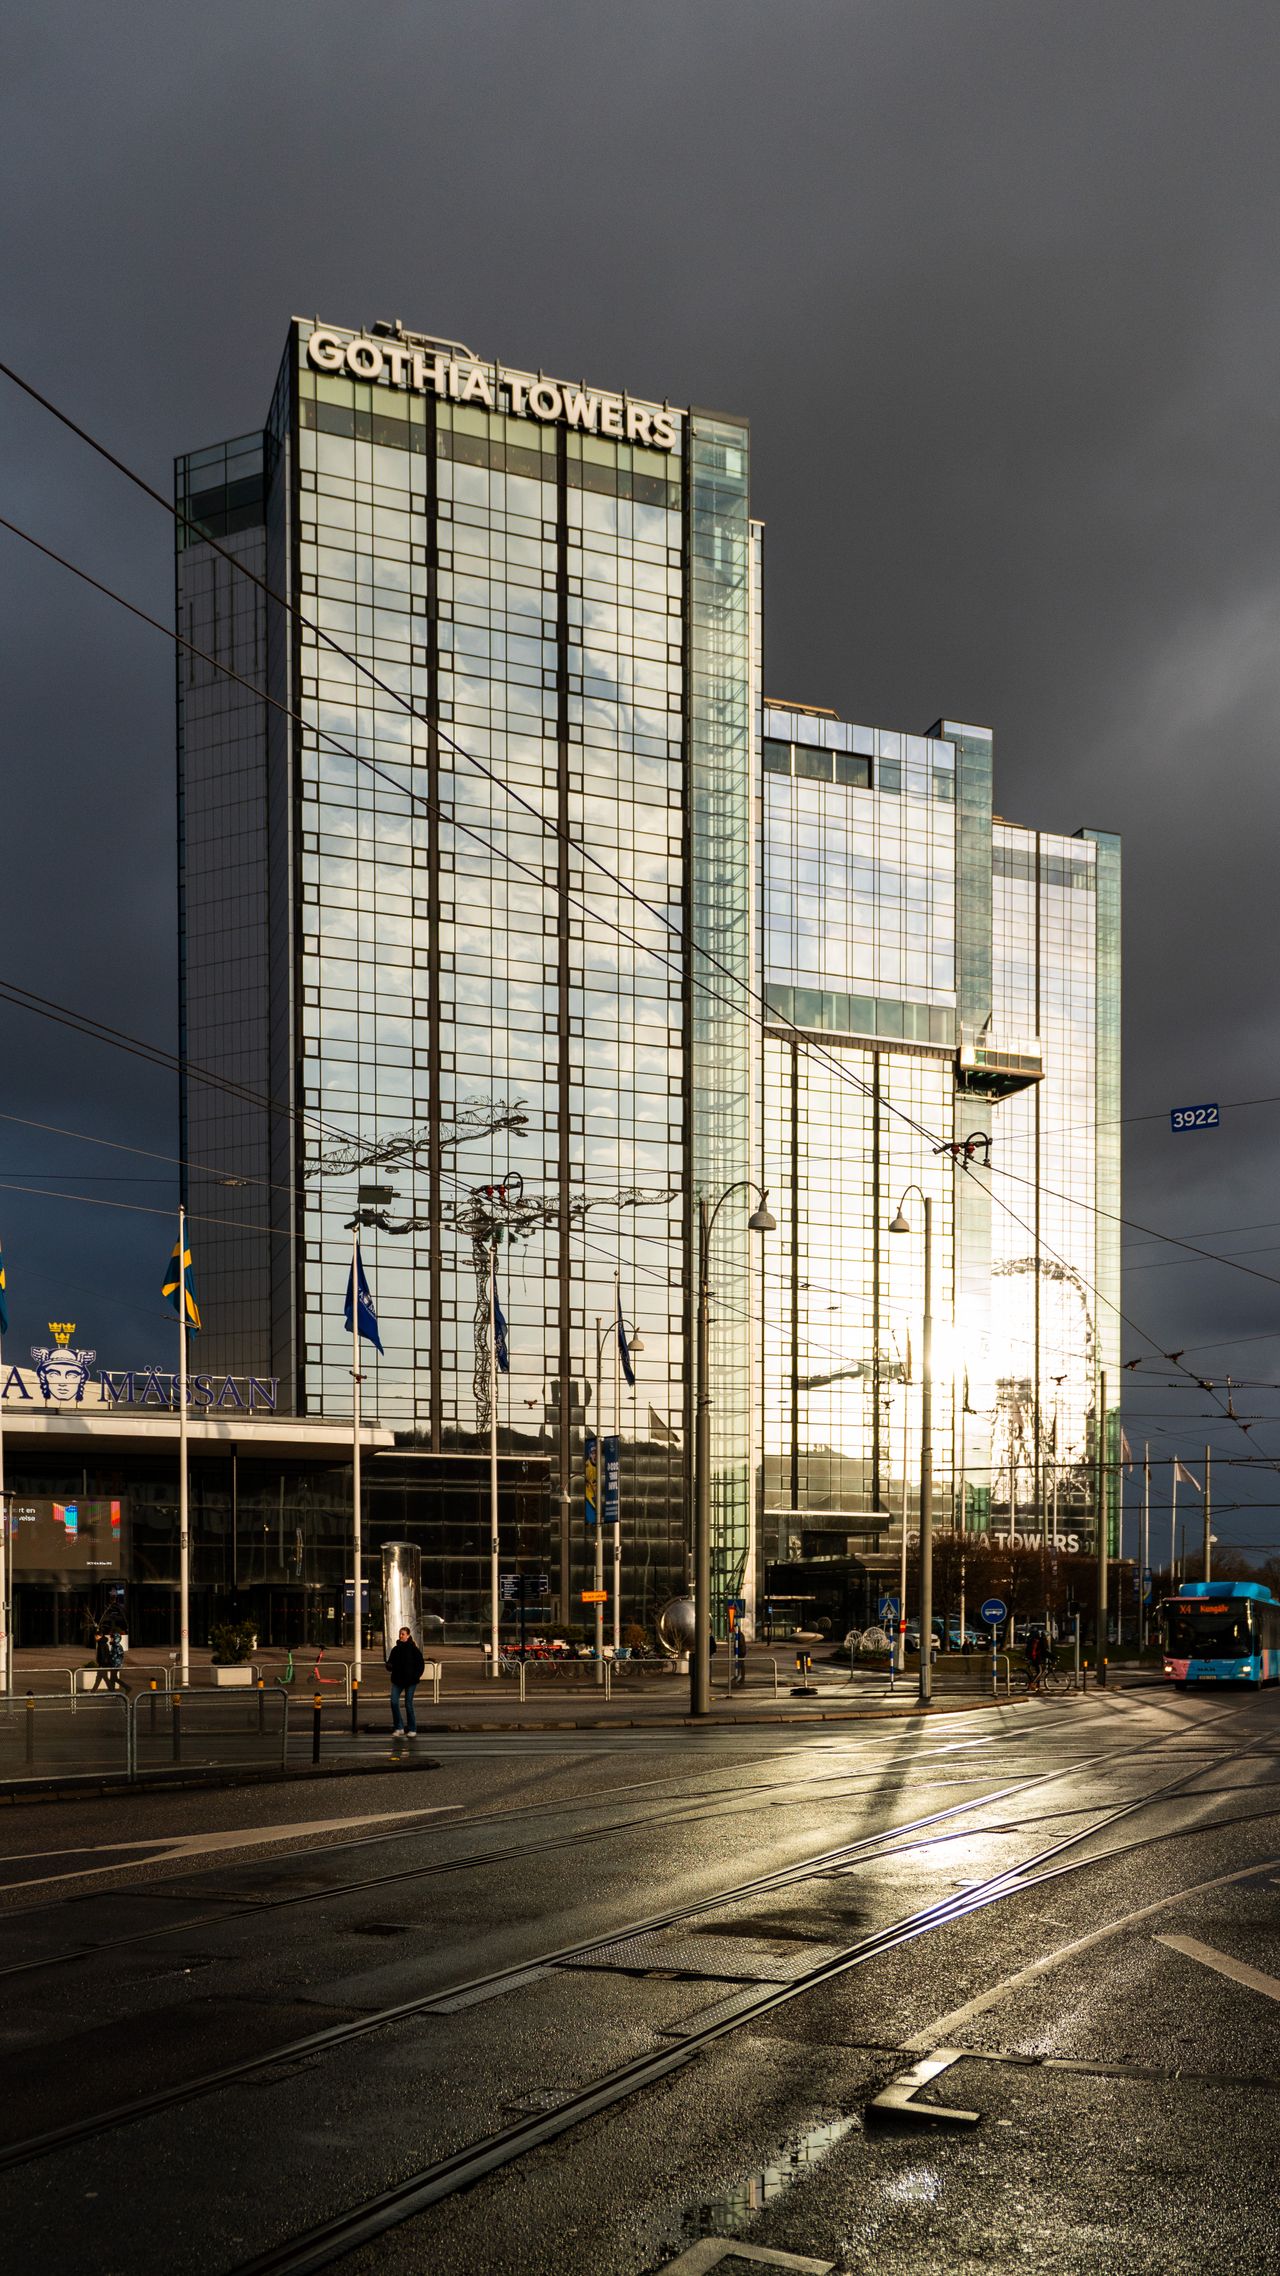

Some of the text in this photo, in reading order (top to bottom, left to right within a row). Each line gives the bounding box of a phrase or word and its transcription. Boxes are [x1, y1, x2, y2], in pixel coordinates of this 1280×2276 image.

[308, 331, 678, 450] GOTHIA TOWERS
[1173, 1108, 1218, 1128] 3922
[97, 1365, 281, 1410] MÄSSAN
